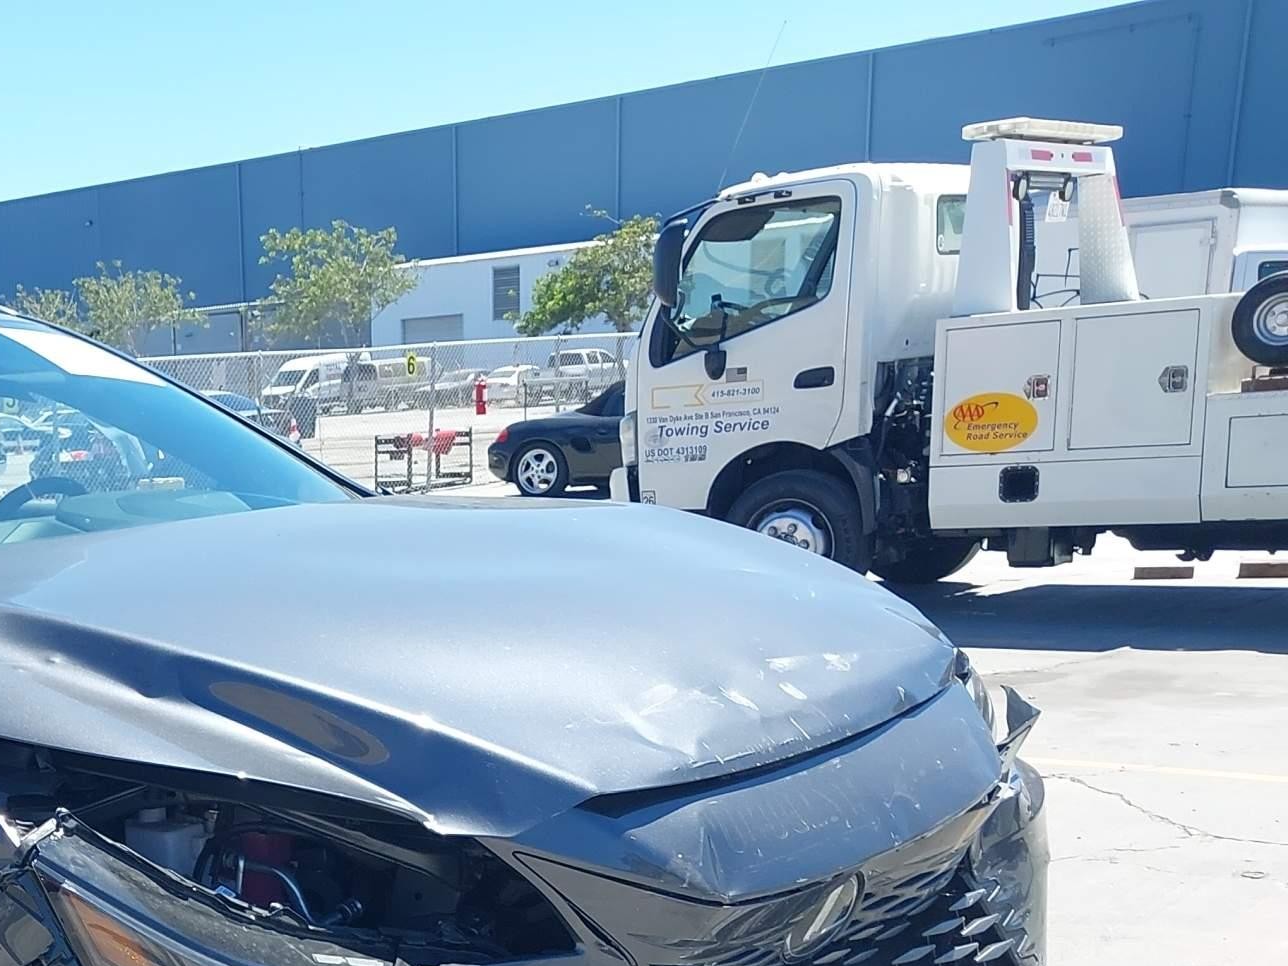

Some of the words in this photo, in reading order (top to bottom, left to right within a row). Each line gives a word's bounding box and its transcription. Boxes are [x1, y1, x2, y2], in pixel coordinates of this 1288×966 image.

[407, 356, 416, 375] 6
[658, 423, 709, 439] Towing
[713, 417, 770, 434] Service
[967, 422, 1019, 431] Emergency
[966, 432, 989, 440] Road
[992, 431, 1028, 440] Service
[644, 449, 656, 458] US
[657, 447, 674, 457] DOT
